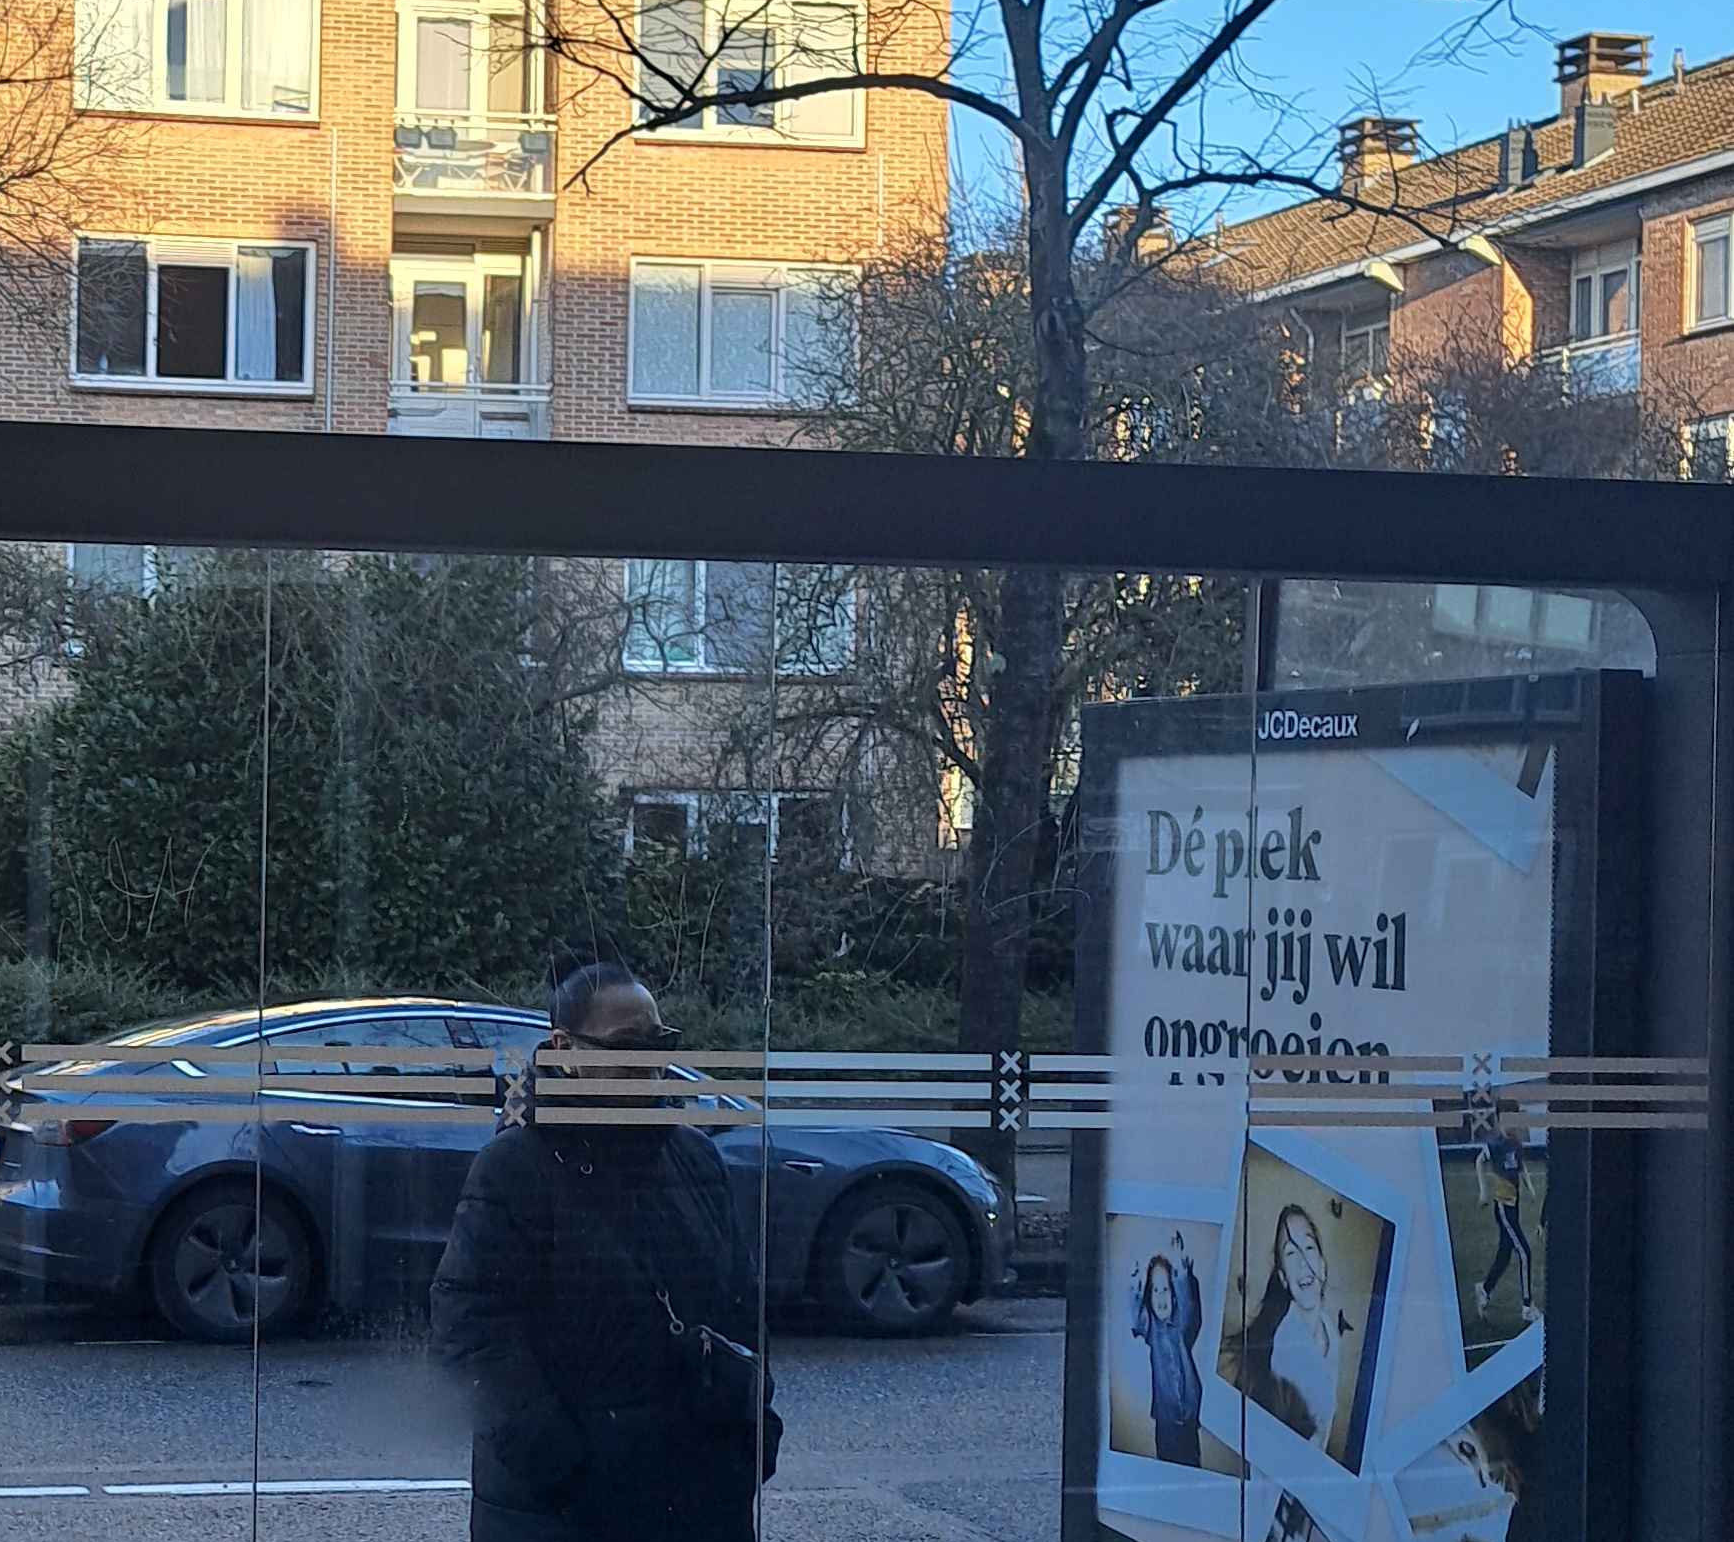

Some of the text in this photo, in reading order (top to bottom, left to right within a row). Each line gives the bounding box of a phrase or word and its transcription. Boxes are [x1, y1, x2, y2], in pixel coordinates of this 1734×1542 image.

[1258, 710, 1358, 739] JCDecaux
[1146, 805, 1322, 898] Dé plek
[1145, 907, 1407, 1005] waar jij wil
